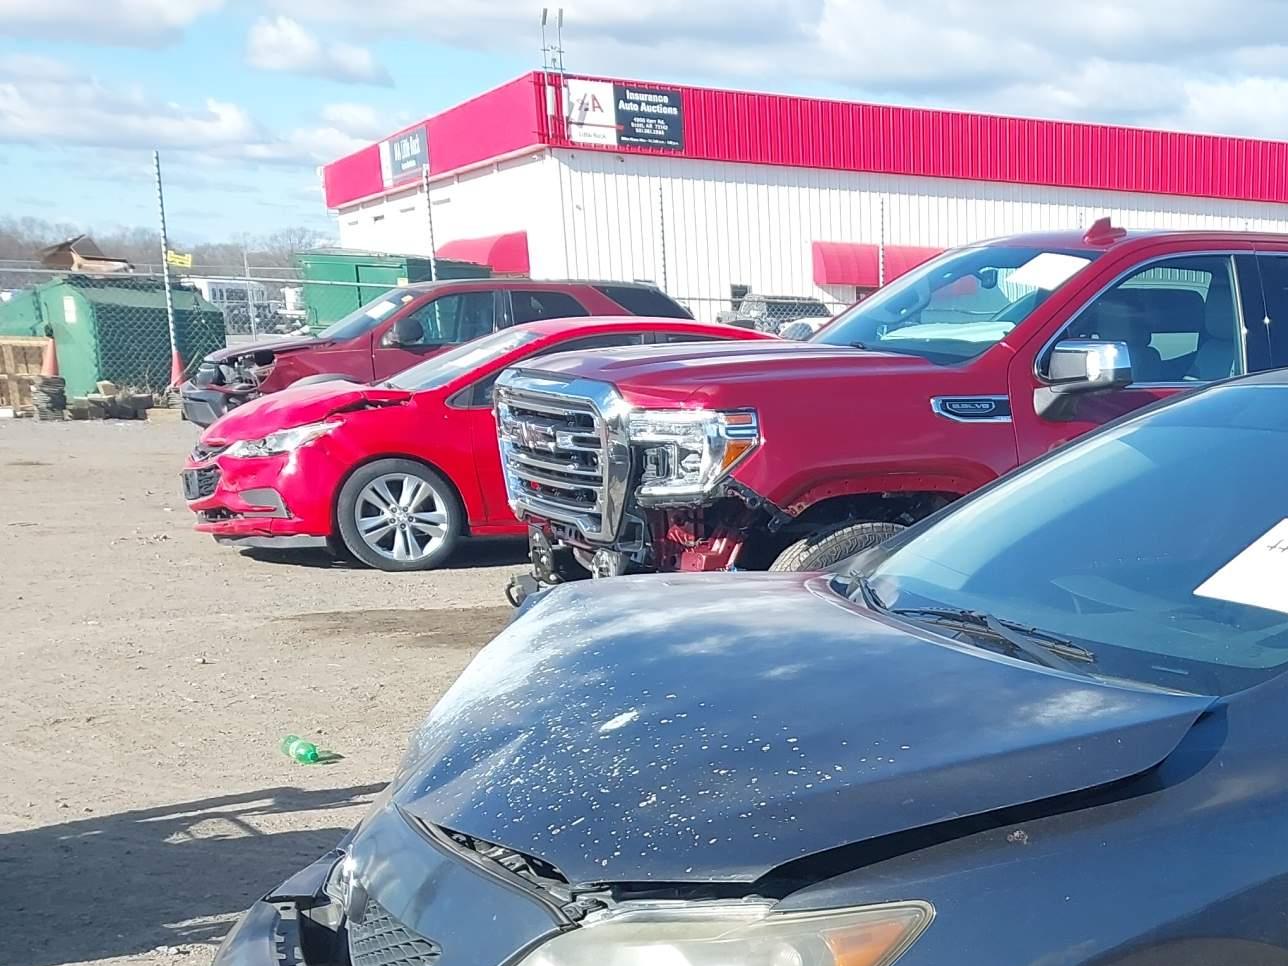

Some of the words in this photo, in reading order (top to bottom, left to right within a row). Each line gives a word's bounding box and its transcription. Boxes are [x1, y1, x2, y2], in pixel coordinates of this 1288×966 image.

[626, 89, 669, 104] Insurance
[618, 100, 639, 111] Auto
[640, 102, 678, 115] Auctions
